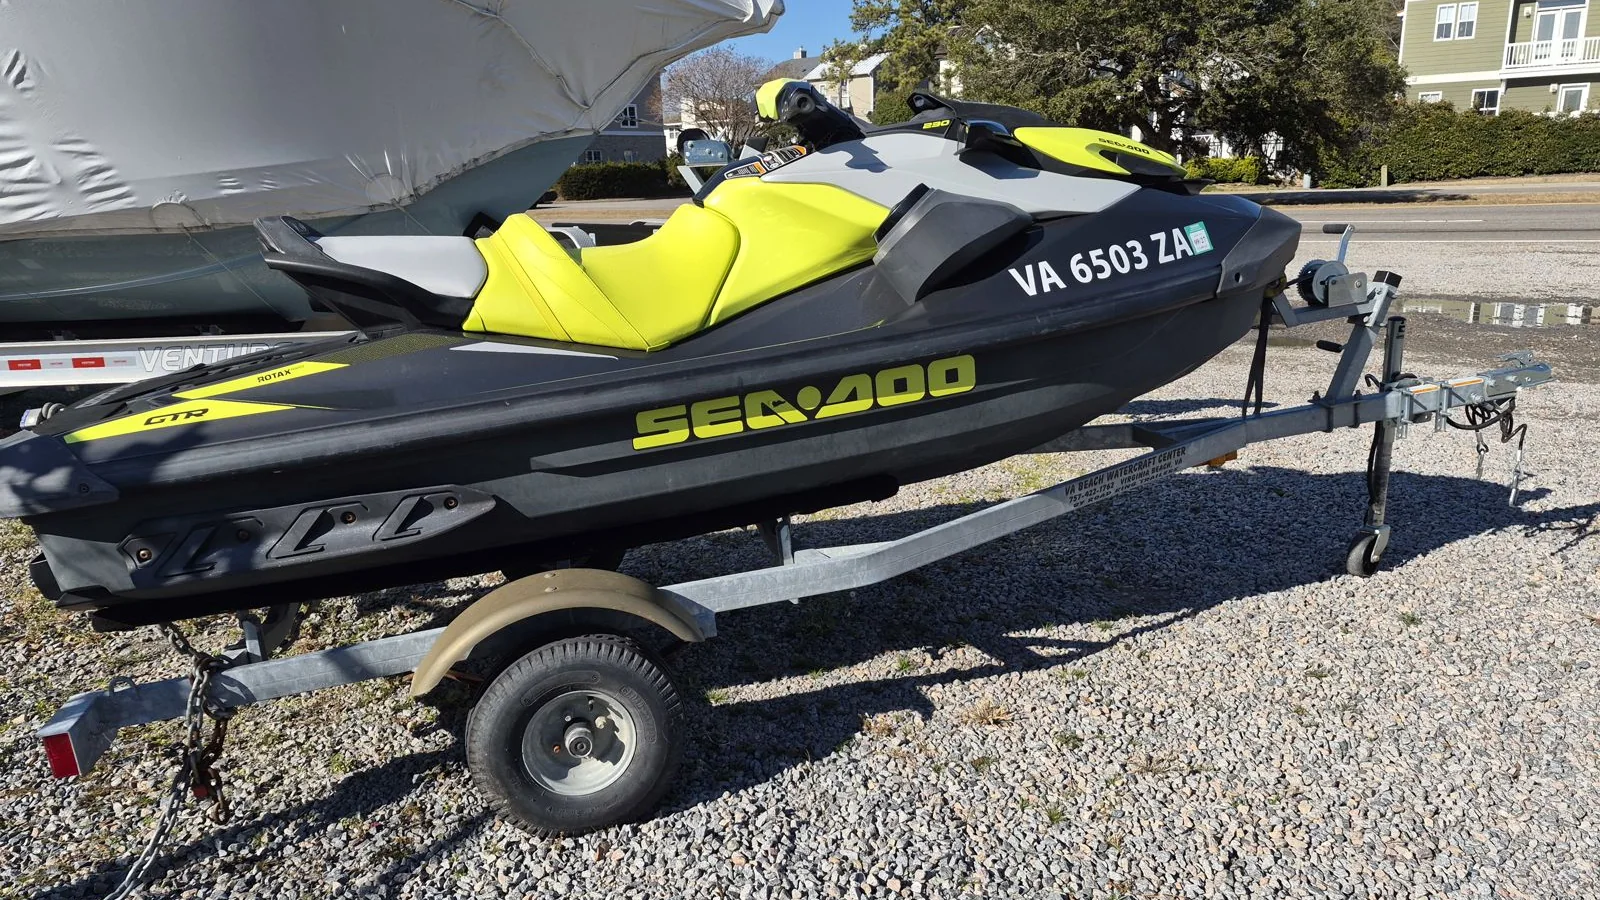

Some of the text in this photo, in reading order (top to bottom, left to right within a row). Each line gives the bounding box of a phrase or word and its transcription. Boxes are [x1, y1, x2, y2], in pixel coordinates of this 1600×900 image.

[922, 119, 951, 130] 230
[1008, 259, 1068, 297] VA
[1070, 239, 1149, 284] 6503
[1150, 227, 1194, 265] ZA
[257, 368, 291, 383] ROTAX
[143, 407, 209, 426] GTR
[1064, 446, 1187, 497] VA BEACH WATERCRAFT CENTER
[1120, 468, 1150, 485] VIRGINIA
